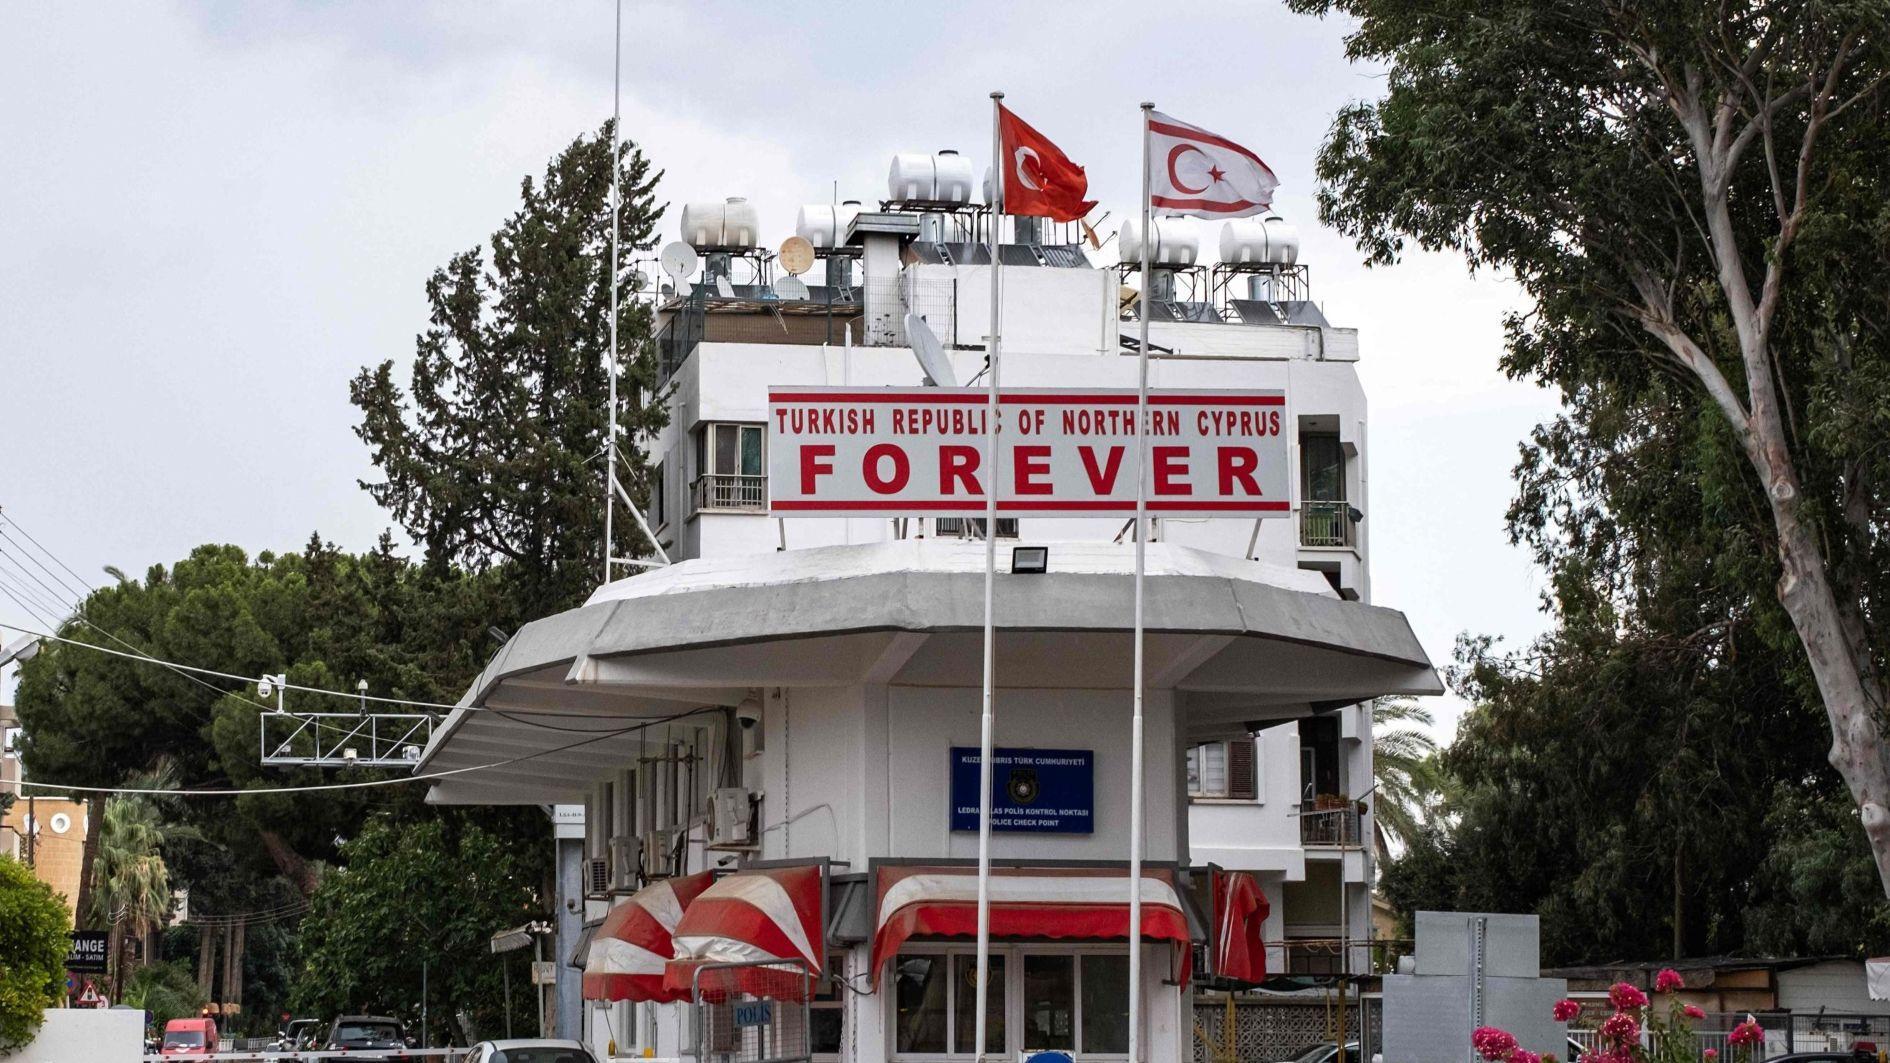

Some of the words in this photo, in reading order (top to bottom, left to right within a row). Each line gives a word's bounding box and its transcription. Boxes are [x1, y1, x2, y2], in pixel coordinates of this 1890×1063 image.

[775, 408, 875, 435] TURKISH
[1018, 409, 1045, 435] OF
[1197, 410, 1281, 437] CYPRUS
[799, 443, 1263, 497] FOREVER
[961, 755, 982, 764] KUZE
[957, 806, 980, 814] LEDRA
[1025, 808, 1058, 816] KONTROL
[1059, 808, 1089, 817] NOKTASI
[1013, 818, 1037, 827] CHECK
[1038, 819, 1060, 827] POINT
[74, 939, 105, 952] ANGE
